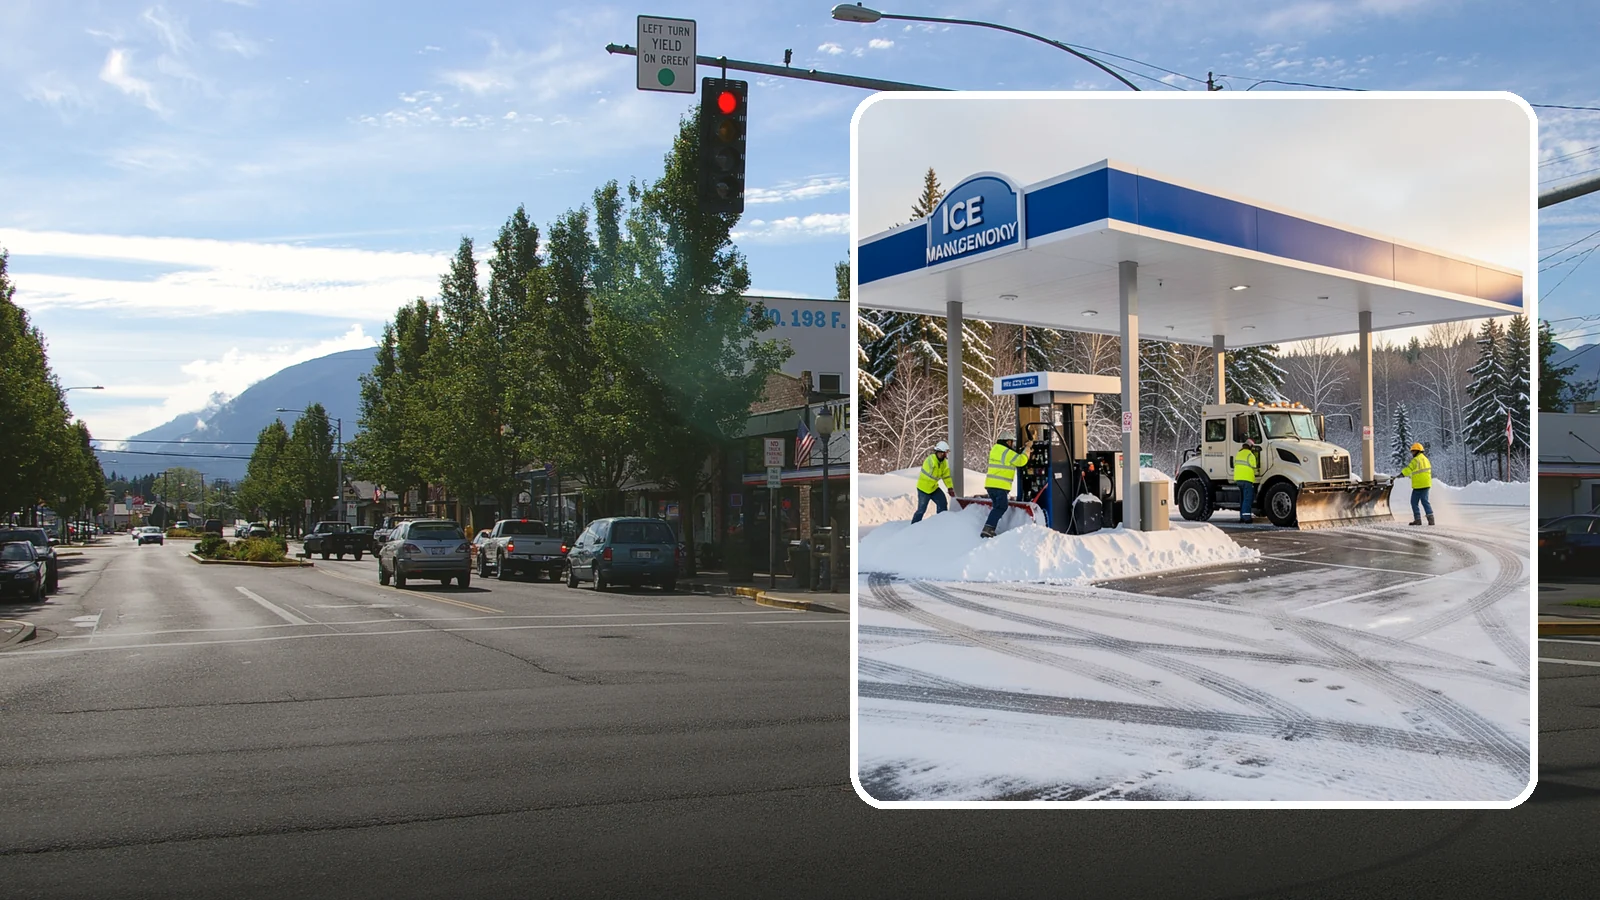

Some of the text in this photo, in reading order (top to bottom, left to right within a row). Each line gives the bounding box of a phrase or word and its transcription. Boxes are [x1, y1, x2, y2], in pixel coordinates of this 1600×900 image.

[643, 24, 690, 36] LEFT TURN
[652, 38, 682, 51] YIELD
[644, 53, 688, 66] ON GREEN
[942, 195, 984, 235] ICE
[791, 309, 826, 328] 198
[831, 311, 846, 329] F.
